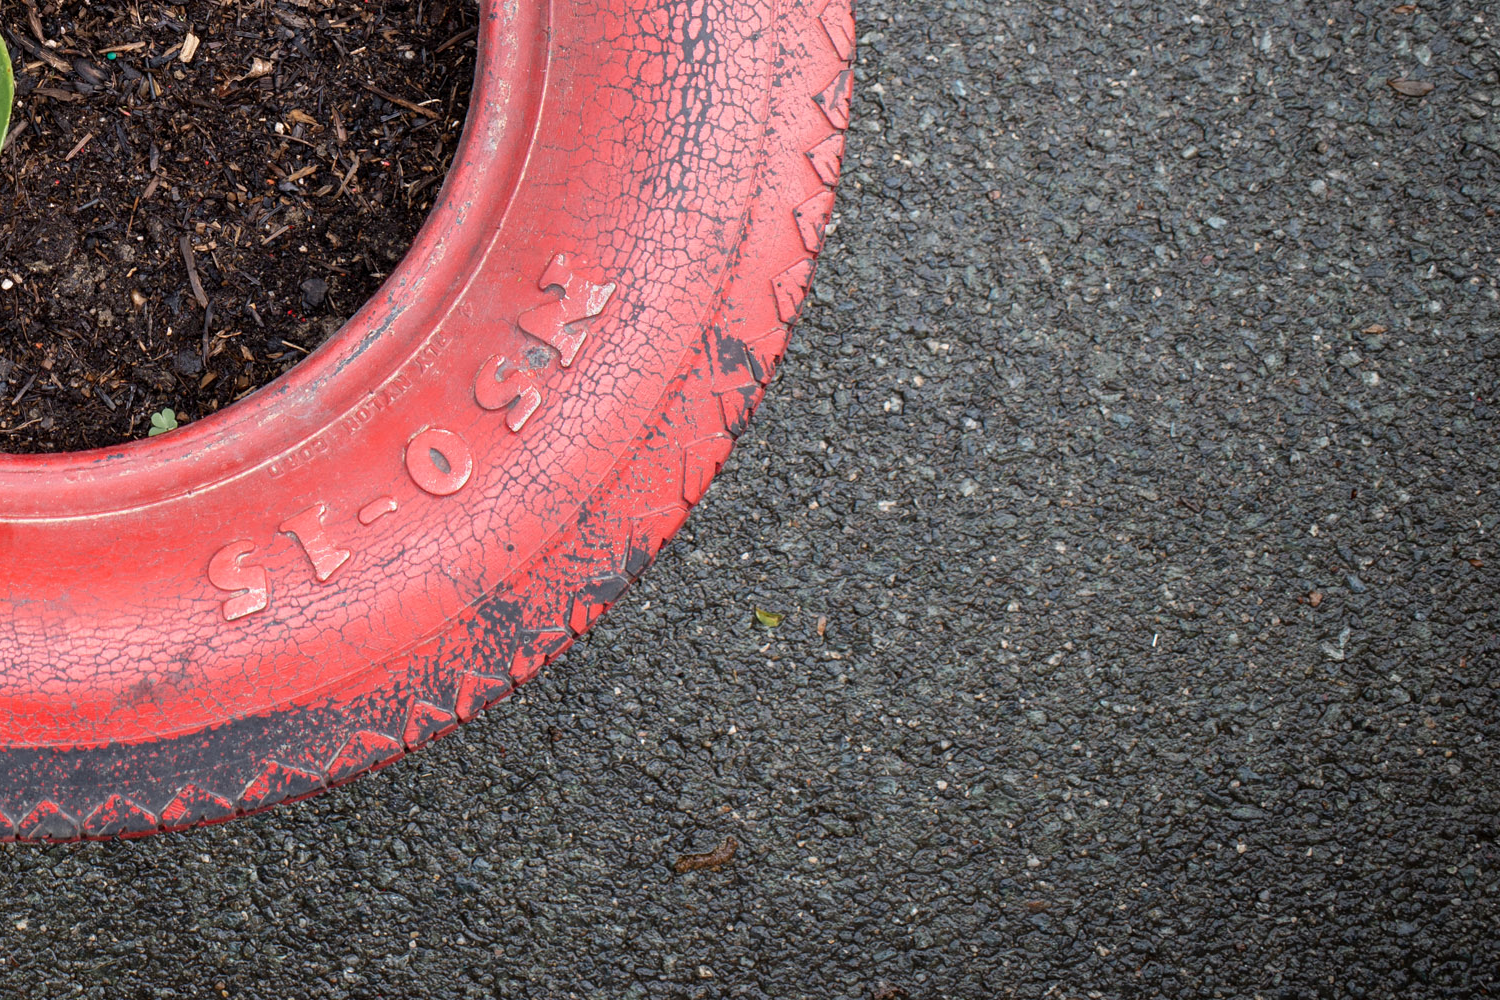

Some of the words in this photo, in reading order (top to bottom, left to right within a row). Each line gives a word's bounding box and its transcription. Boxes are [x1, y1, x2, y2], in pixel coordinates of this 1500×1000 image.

[412, 330, 452, 374] PLY
[342, 374, 412, 434] NYLON
[207, 252, 616, 622] N50-15
[267, 436, 328, 480] CORD
